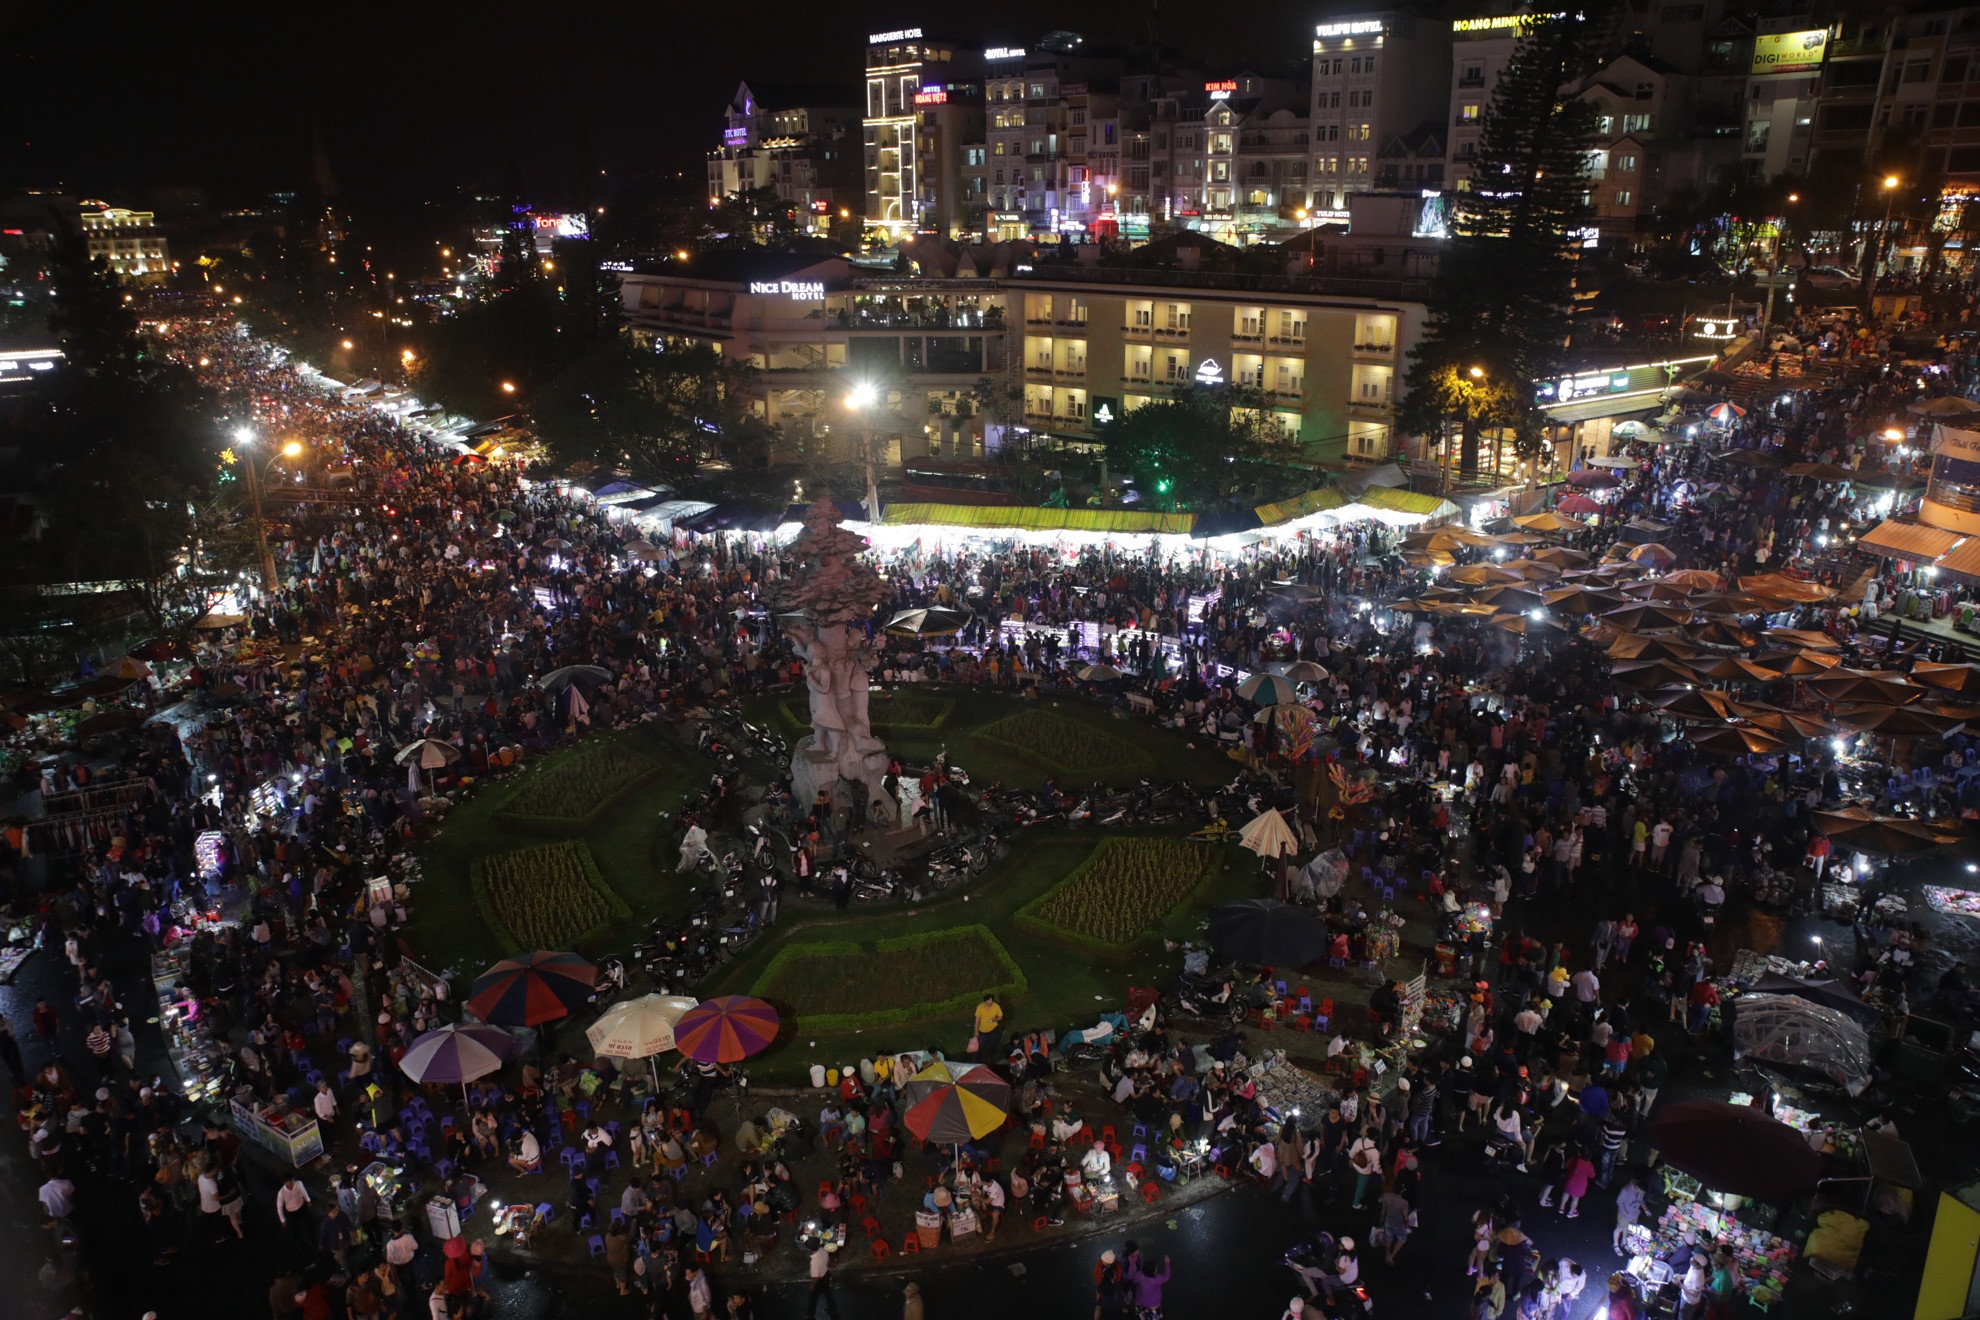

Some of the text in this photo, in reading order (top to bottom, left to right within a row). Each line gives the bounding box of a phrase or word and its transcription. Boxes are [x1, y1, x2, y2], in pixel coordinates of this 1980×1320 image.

[1351, 21, 1383, 33] HOTEL
[905, 28, 923, 38] HOTEL
[1205, 80, 1237, 91] KIM HÒA
[750, 281, 824, 293] NICE DREAM
[792, 292, 825, 300] HOTEL
